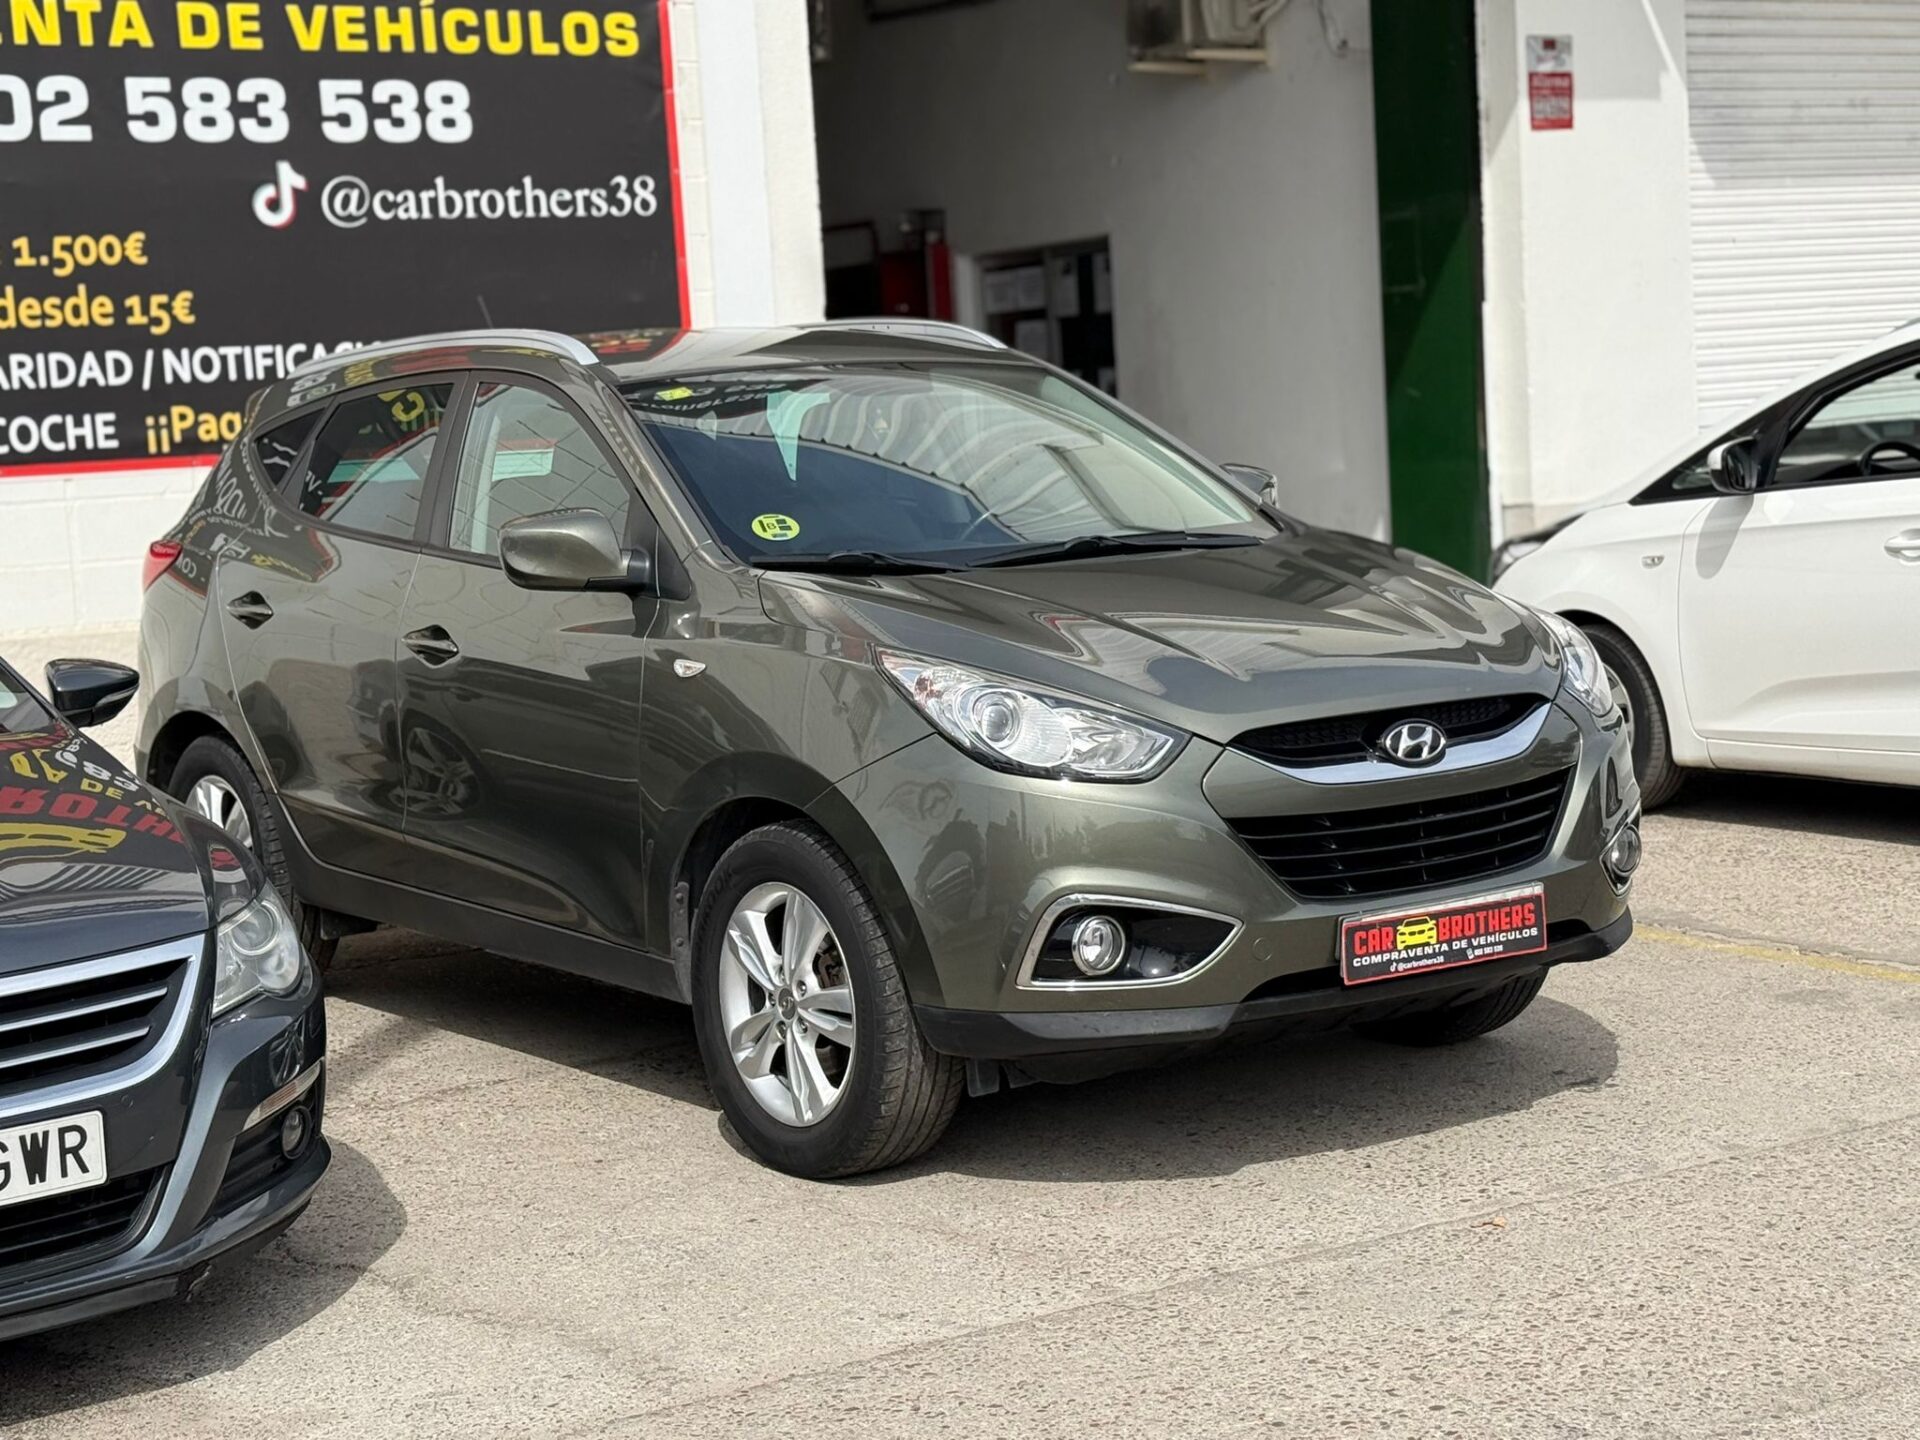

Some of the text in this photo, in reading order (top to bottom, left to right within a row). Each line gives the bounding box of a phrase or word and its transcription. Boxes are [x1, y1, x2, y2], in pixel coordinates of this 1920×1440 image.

[0, 0, 640, 57] NTA DE VEHÍCULOS
[124, 76, 290, 143] 583
[318, 79, 473, 144] 538
[321, 175, 657, 228] @carbrothers38
[12, 231, 148, 277] 1.500€
[0, 283, 196, 335] desde 15€
[142, 348, 154, 391] /
[162, 341, 383, 384] NOTIFIC
[1352, 927, 1538, 967] COMPRAVENTA DE VEHÍCULOS
[1354, 902, 1536, 956] CAR BROTHERS
